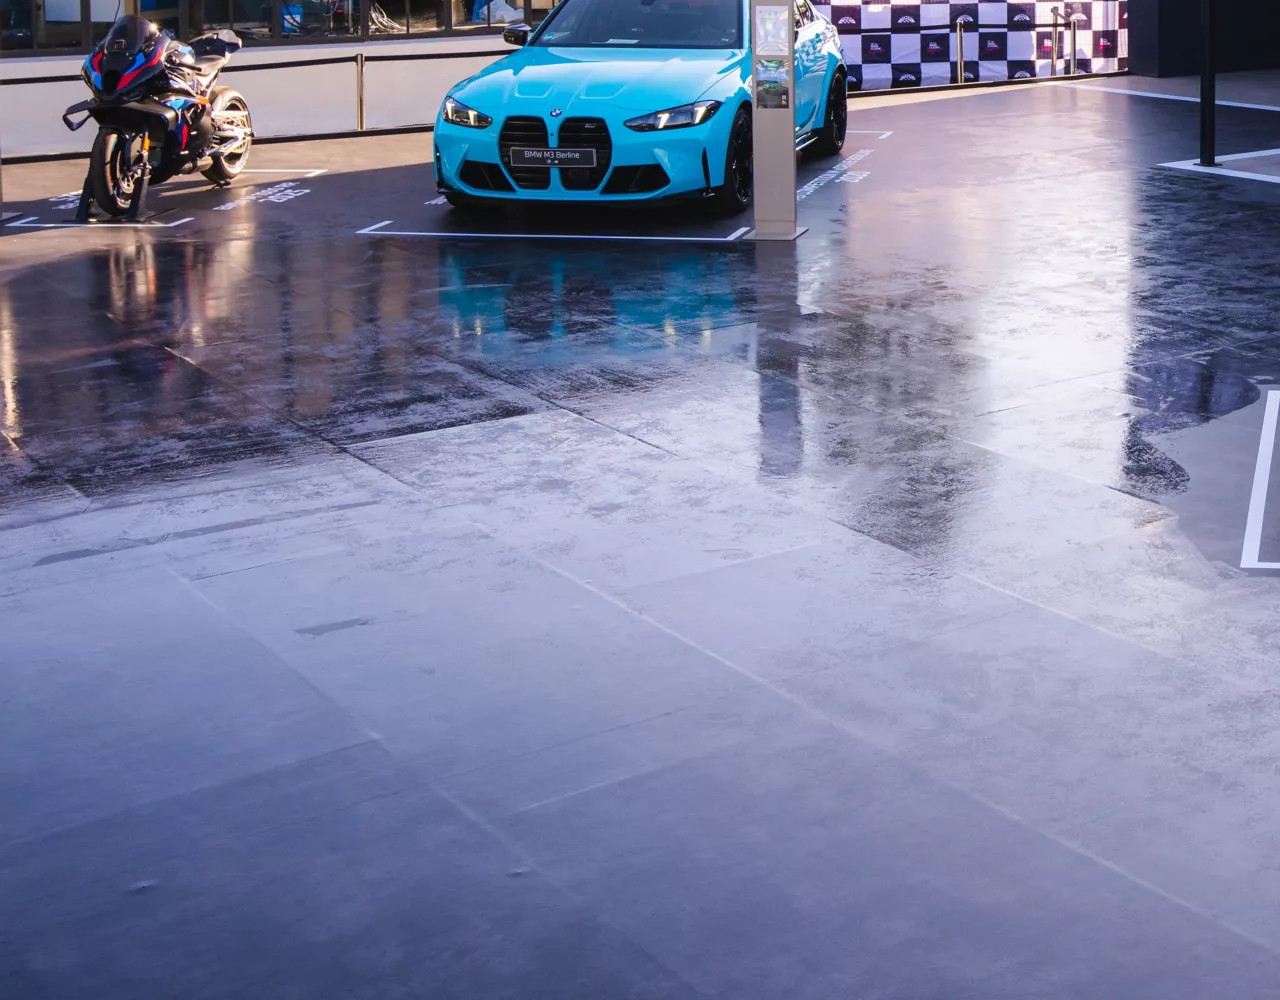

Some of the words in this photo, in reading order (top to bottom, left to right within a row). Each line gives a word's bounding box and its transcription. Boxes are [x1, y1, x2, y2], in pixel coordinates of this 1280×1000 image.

[524, 150, 542, 158] BMW
[543, 150, 555, 158] M3
[555, 151, 580, 159] Berline
